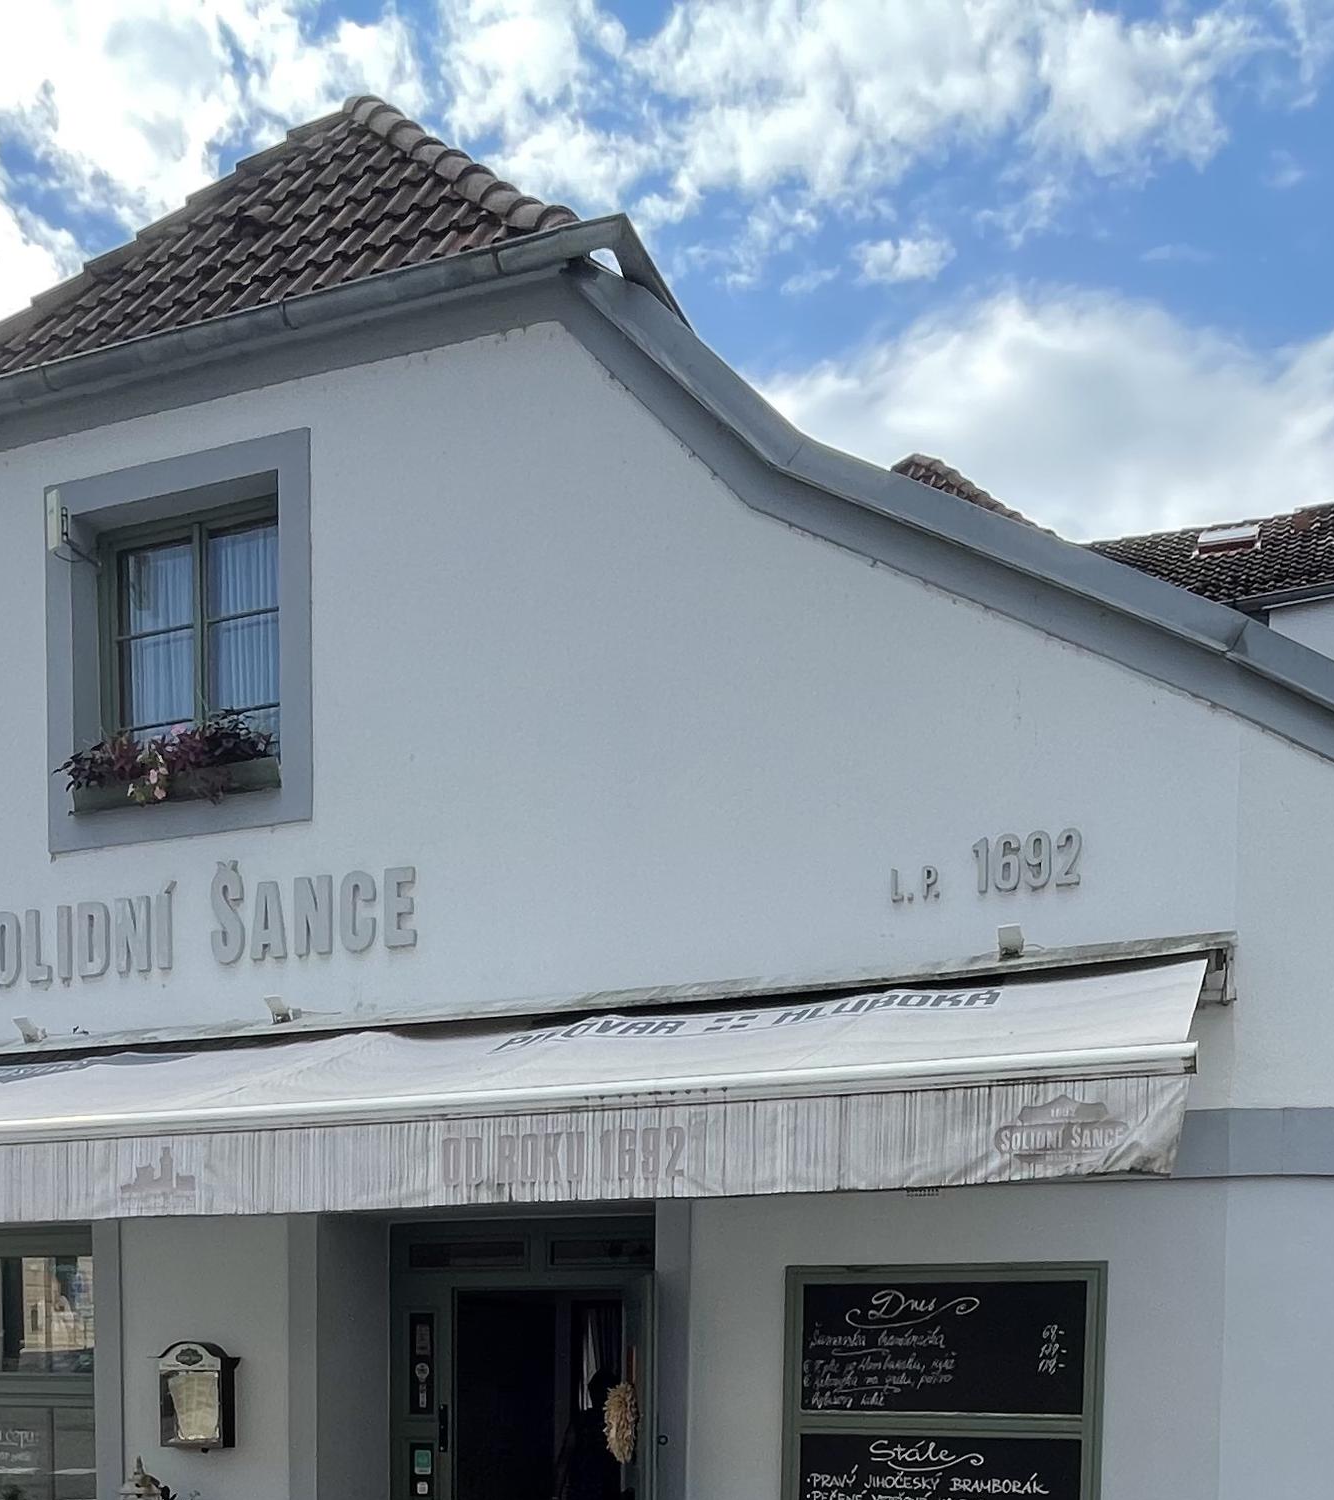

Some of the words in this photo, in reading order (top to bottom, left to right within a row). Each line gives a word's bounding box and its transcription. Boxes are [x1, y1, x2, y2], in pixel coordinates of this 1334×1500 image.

[971, 828, 1083, 895] 1692
[210, 860, 417, 965] ŠANCE
[772, 989, 1001, 1025] HLUBOKÁ
[442, 1136, 484, 1187] OD
[497, 1130, 585, 1175] ROKU
[598, 1126, 685, 1180] 1692
[869, 1440, 955, 1461] Stále
[810, 1464, 858, 1488] PRAVÝ
[864, 1471, 943, 1490] JIHOČESKÝ
[949, 1472, 1050, 1494] BRAMBORÁK
